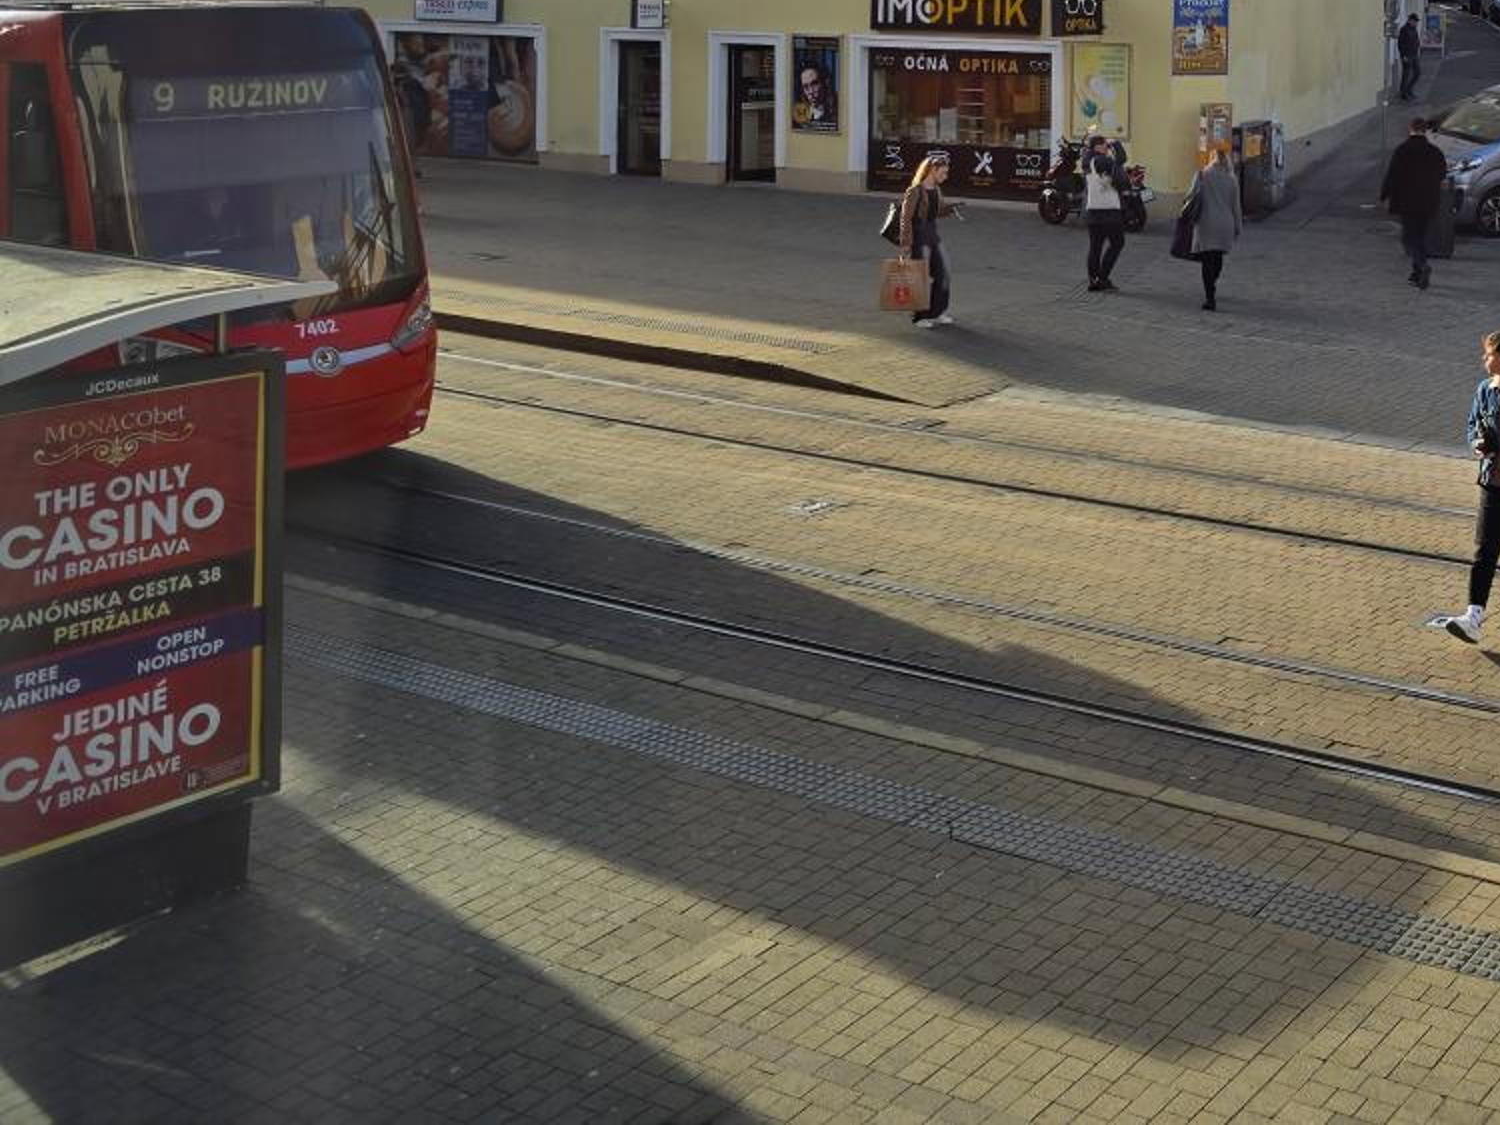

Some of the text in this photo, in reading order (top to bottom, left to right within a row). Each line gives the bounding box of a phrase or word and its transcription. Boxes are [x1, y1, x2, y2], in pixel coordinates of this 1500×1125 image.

[904, 54, 1019, 74] OČNÁ OPTIKA
[154, 82, 175, 112] 9
[294, 319, 340, 339] 7402
[85, 373, 160, 396] JCDecaux
[34, 462, 193, 518] THE ONLY
[0, 487, 226, 570] CASINO
[34, 538, 191, 586] IN BRATISLAVA
[129, 574, 193, 603] CESTA
[199, 566, 222, 586] 38
[53, 600, 172, 645] PETRŽALKA
[157, 626, 207, 651] OPEN
[136, 638, 225, 676] NONSTOP
[15, 664, 60, 690] FREE
[53, 679, 169, 743] JEDINÉ
[0, 703, 221, 803] CASINO
[36, 795, 54, 816] V
[58, 756, 182, 808] BRATISLAVE
